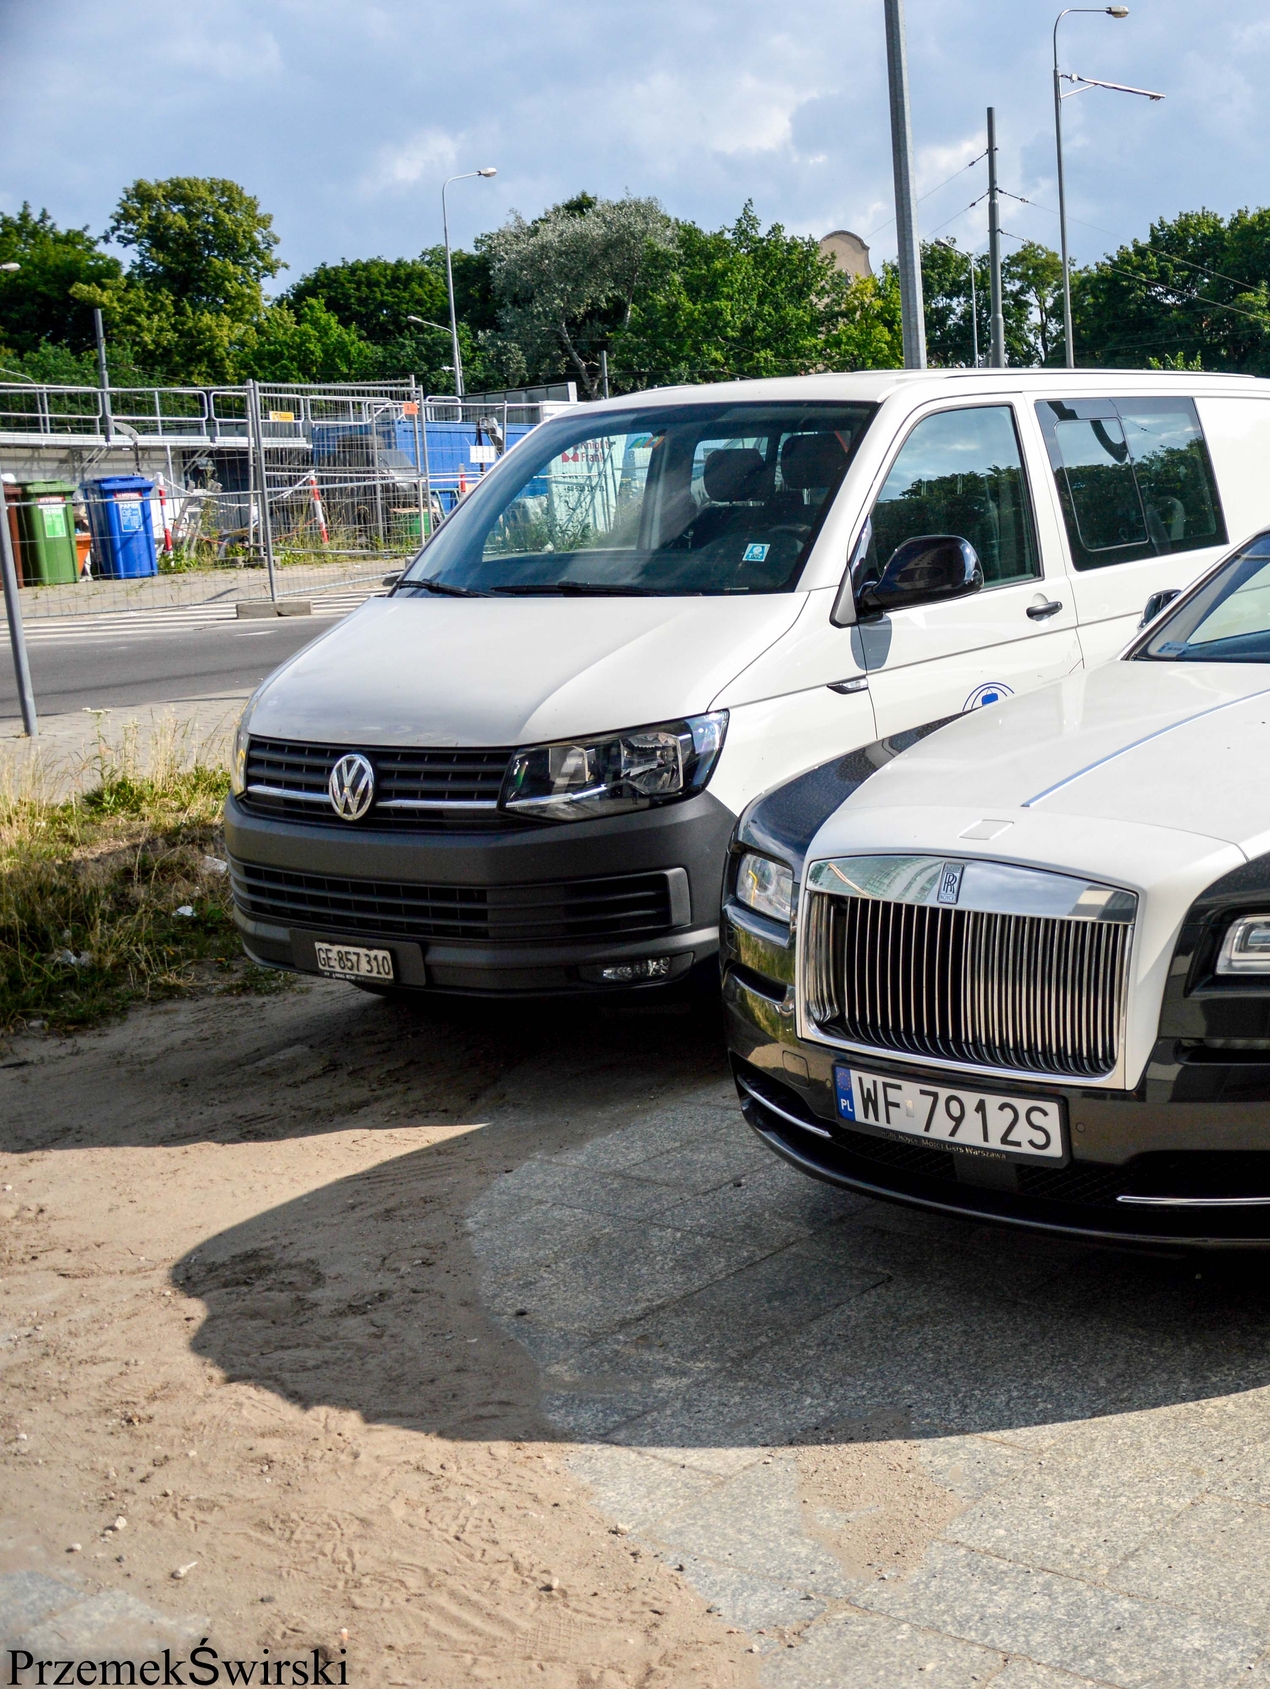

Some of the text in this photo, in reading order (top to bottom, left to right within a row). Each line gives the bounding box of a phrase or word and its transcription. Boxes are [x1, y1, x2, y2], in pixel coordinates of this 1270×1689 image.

[364, 953, 391, 976] 310
[840, 1098, 853, 1112] PL
[858, 1076, 1052, 1151] WF 7912S
[965, 1146, 1007, 1160] Warszawa
